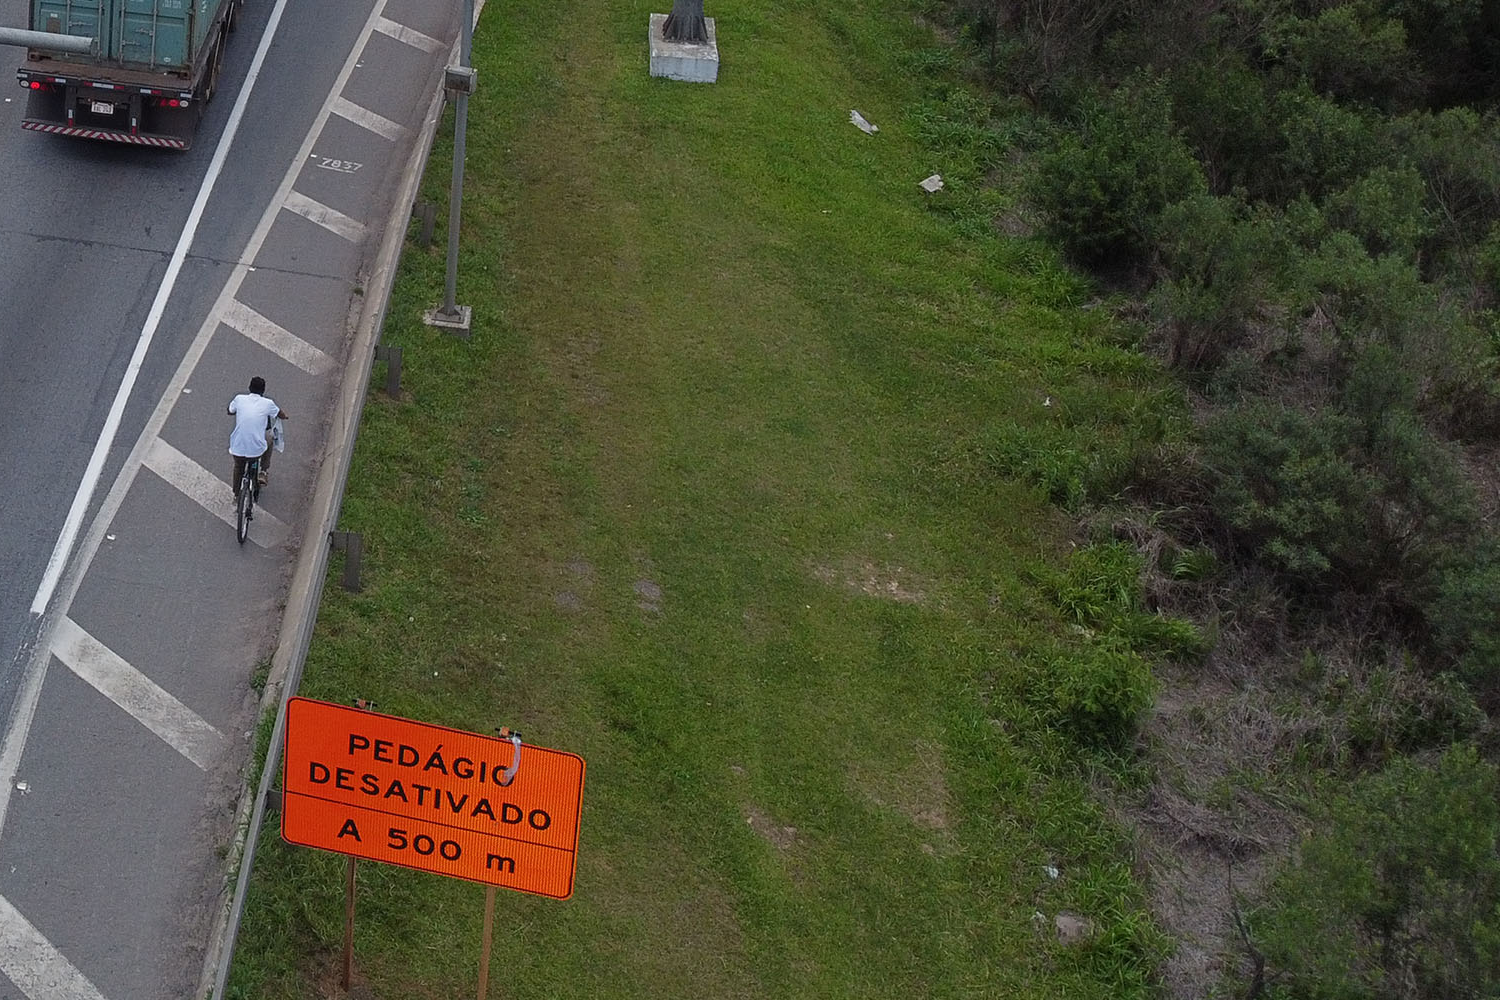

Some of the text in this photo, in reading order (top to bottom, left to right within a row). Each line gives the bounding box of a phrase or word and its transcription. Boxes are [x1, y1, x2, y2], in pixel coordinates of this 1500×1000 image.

[348, 733, 515, 786] PEDÁGIO
[309, 761, 551, 831] DESATIVADO
[337, 818, 516, 874] A 500 m
